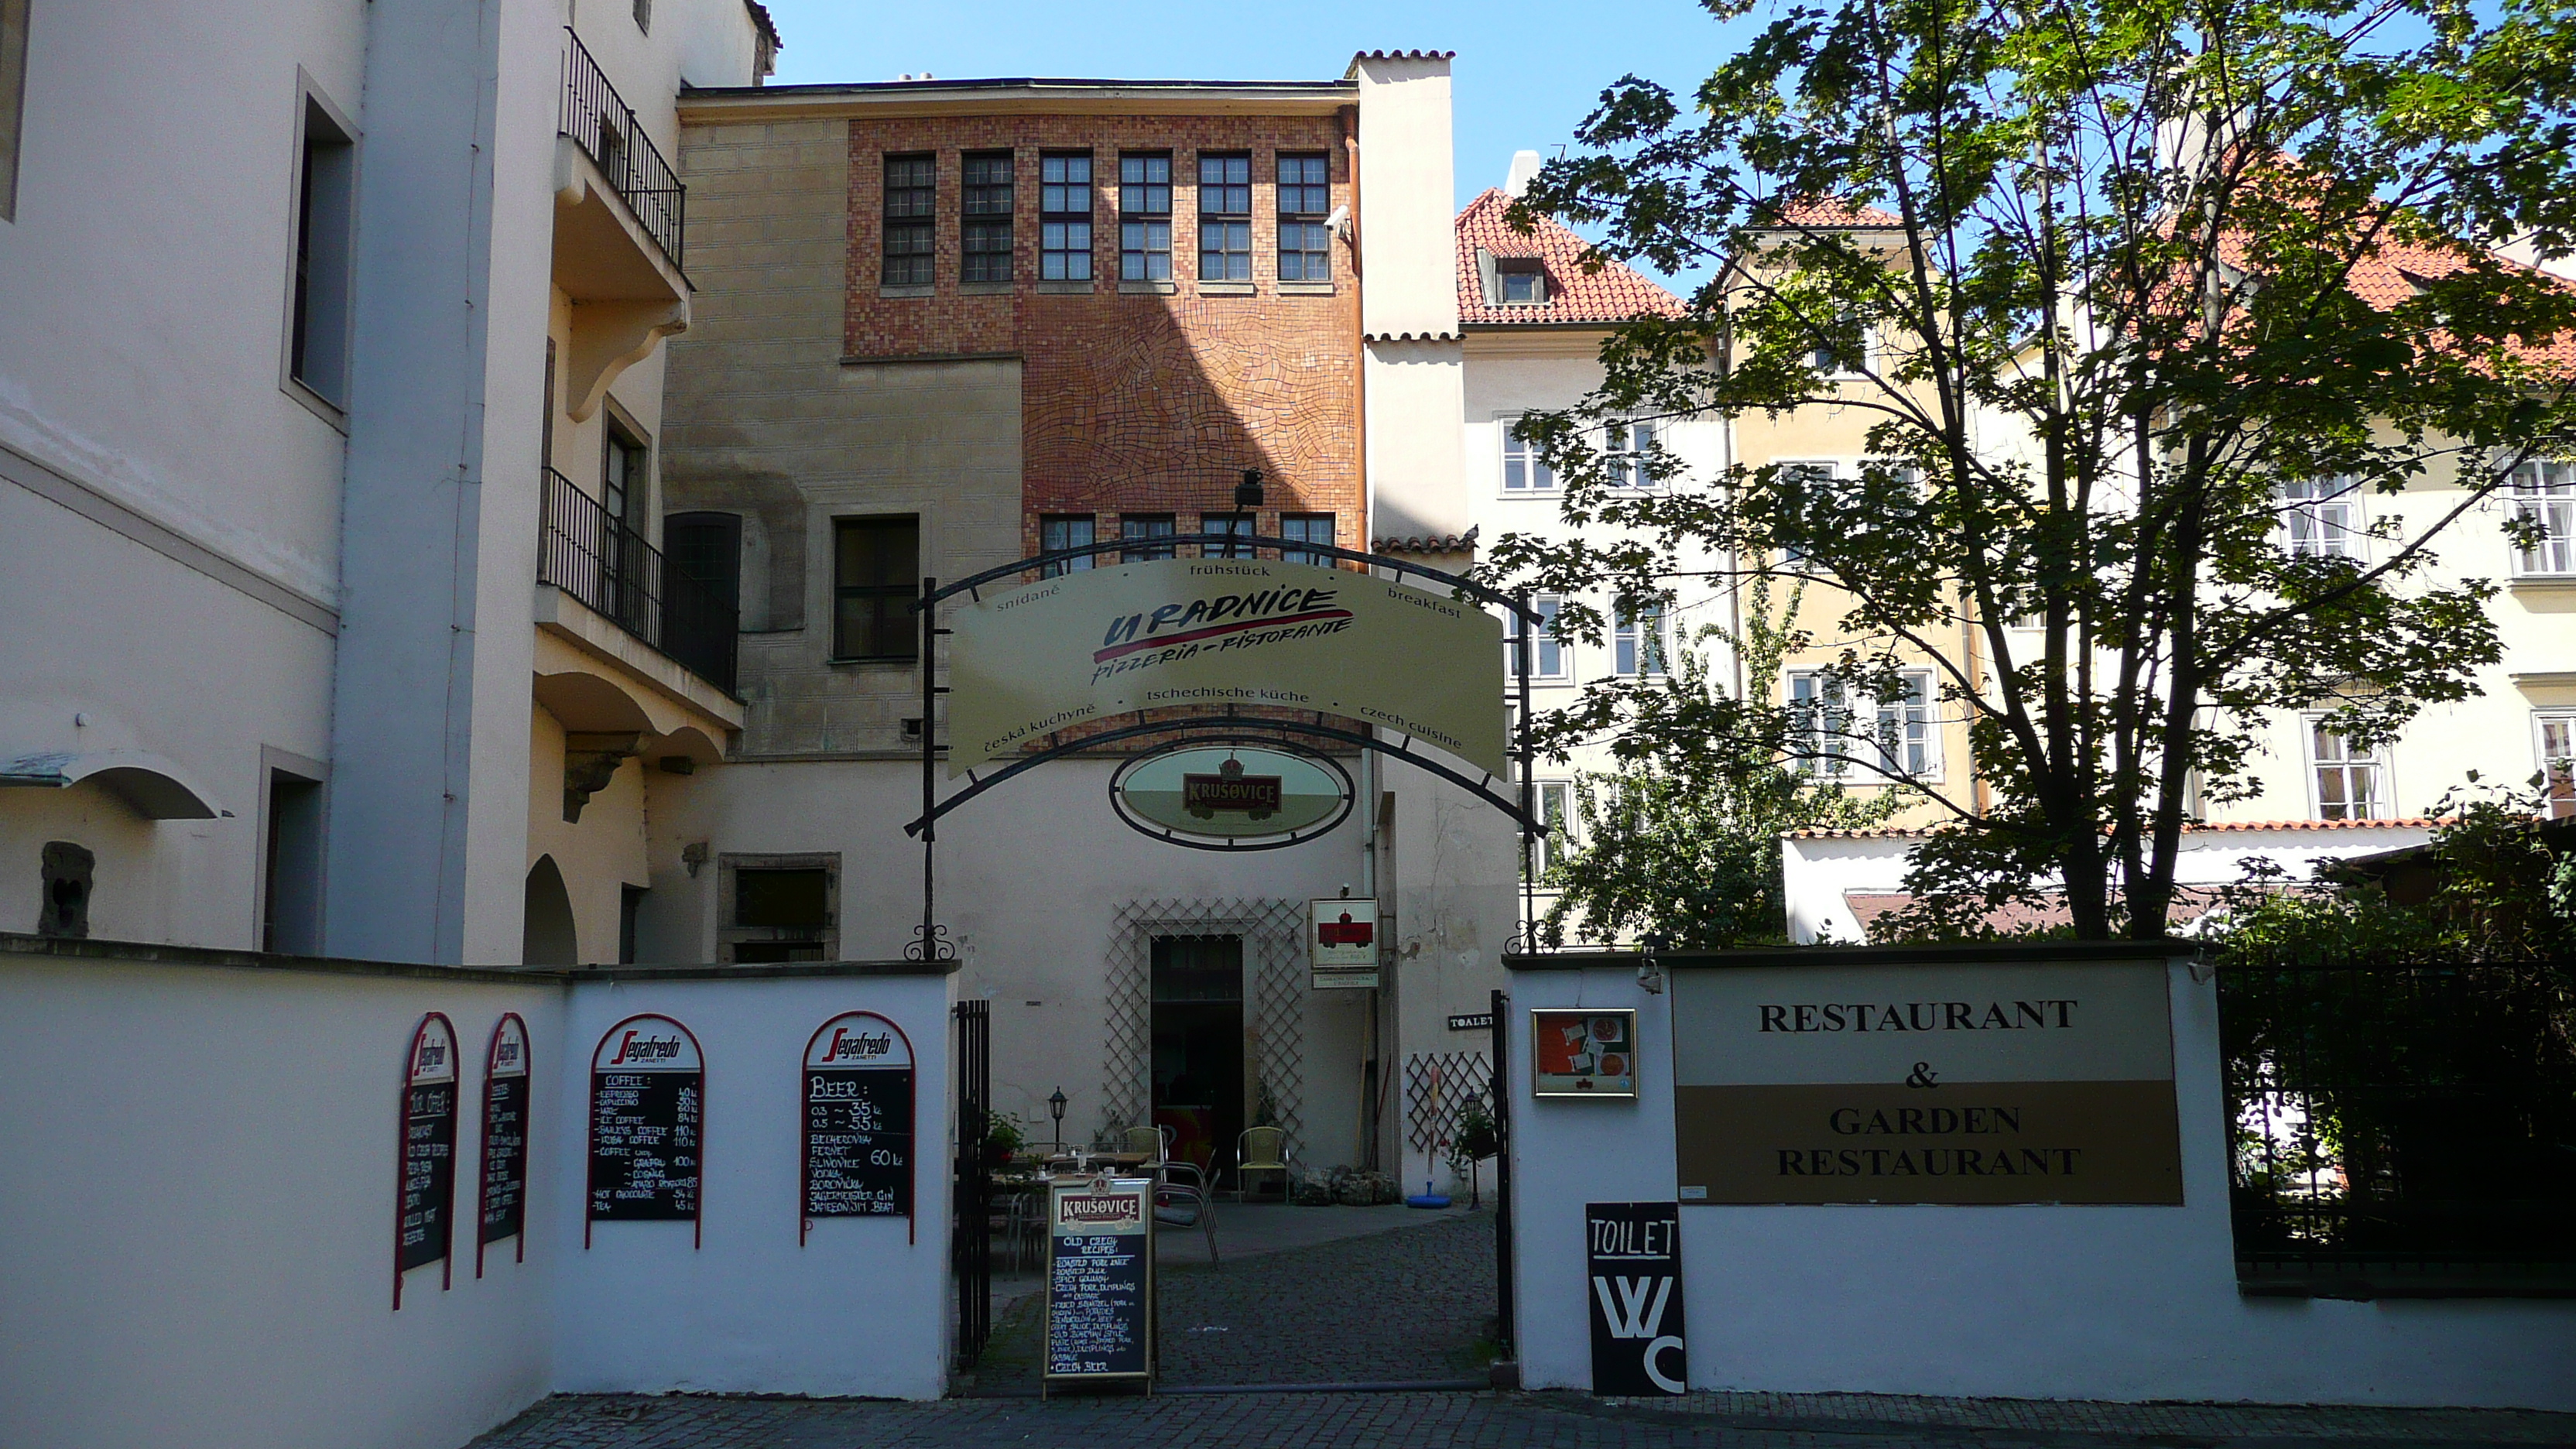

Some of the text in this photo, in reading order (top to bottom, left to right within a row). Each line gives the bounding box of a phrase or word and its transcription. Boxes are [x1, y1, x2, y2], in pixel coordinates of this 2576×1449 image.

[1190, 564, 1270, 576] frühstück
[996, 584, 1060, 611] snídaně
[1147, 584, 1338, 634] RADNICE
[1388, 586, 1461, 618] breakfast
[1146, 687, 1310, 703] tschechische küche
[984, 704, 1096, 752] česká kuchyně
[1360, 705, 1462, 749] czech cuisine
[1189, 781, 1275, 803] KRUŠOVICE
[1757, 1000, 2078, 1033] RESTAURANT
[610, 1030, 681, 1064] Segafredo
[821, 1028, 891, 1062] Segafredo
[1906, 1061, 1941, 1088] &
[848, 1101, 872, 1115] 35
[1829, 1107, 2020, 1136] GARDEN
[848, 1115, 872, 1131] 55
[870, 1149, 891, 1166] 60
[1776, 1148, 2081, 1176] RESTAURANT
[1064, 1197, 1137, 1217] KRUŠOVICE
[1063, 1237, 1083, 1246] OLD
[1591, 1219, 1676, 1254] TOILET
